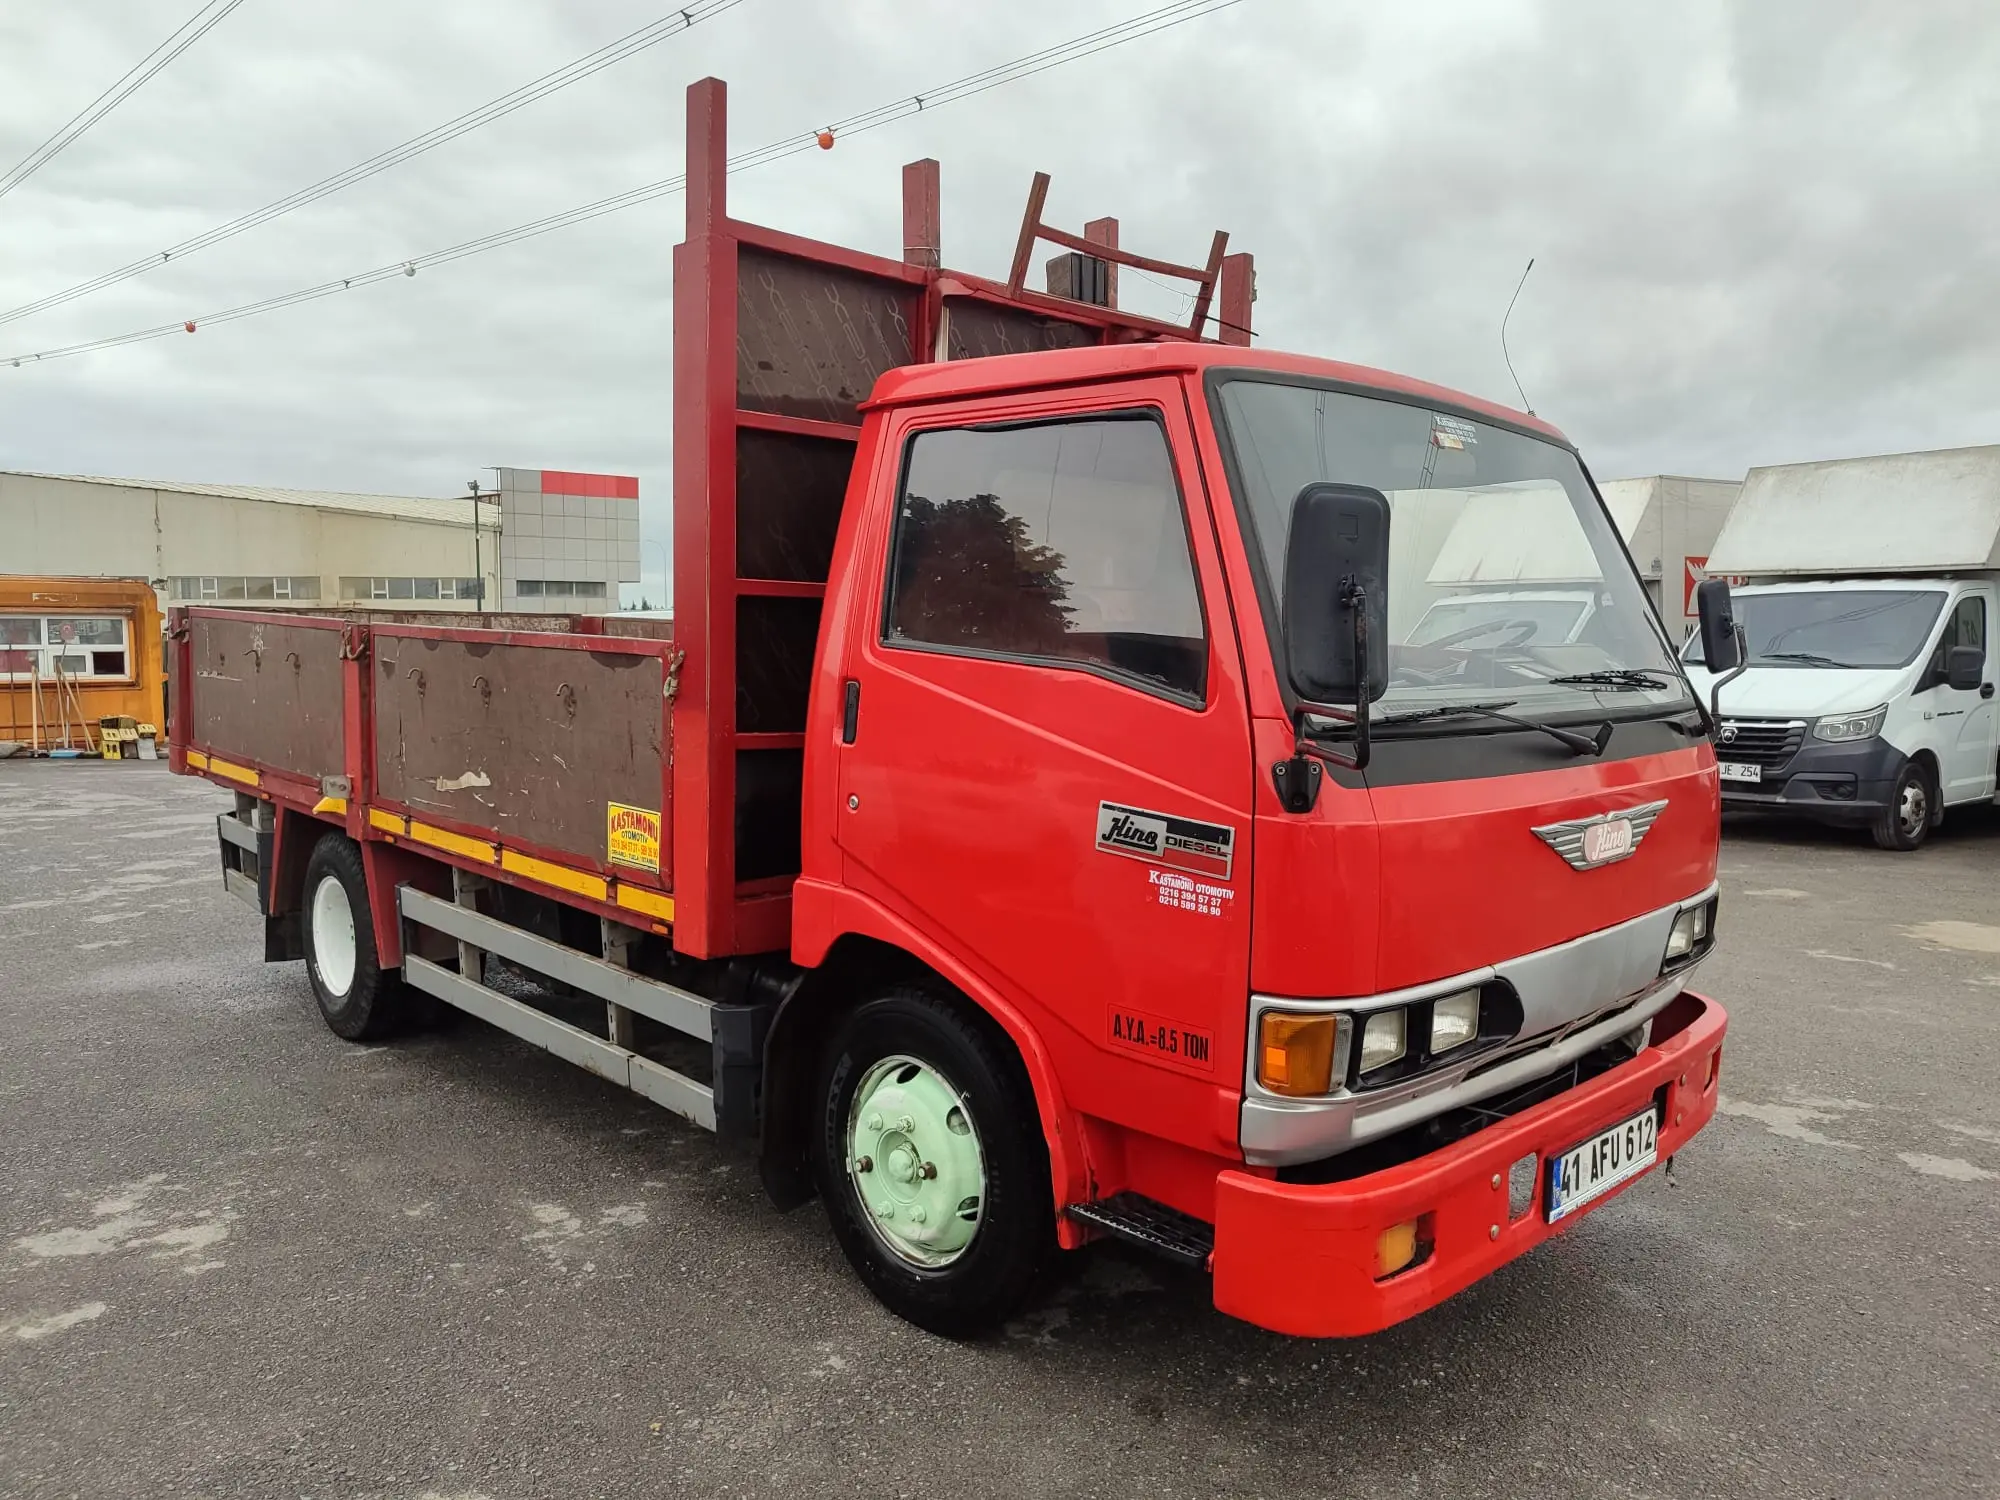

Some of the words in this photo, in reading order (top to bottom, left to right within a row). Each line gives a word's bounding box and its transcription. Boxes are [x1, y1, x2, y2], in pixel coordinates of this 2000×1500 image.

[1740, 765, 1758, 777] 254
[611, 811, 658, 842] KASTAMONU
[1101, 815, 1158, 851] Hino
[1165, 835, 1228, 857] DIESEL
[1592, 824, 1625, 860] Hino
[1148, 869, 1194, 891] KASTAMONU
[1159, 886, 1179, 898] 0216
[1181, 890, 1196, 902] 394
[1198, 894, 1209, 904] 57
[1210, 897, 1222, 907] 37
[1159, 895, 1179, 907] 0216
[1197, 904, 1208, 914] 26
[1210, 907, 1221, 916] 90
[1113, 1013, 1178, 1053] A.Y.A.=8.5
[1182, 1031, 1209, 1062] TON
[1561, 1152, 1580, 1198] 41
[1590, 1132, 1620, 1183] AFU
[1625, 1115, 1653, 1162] 612
